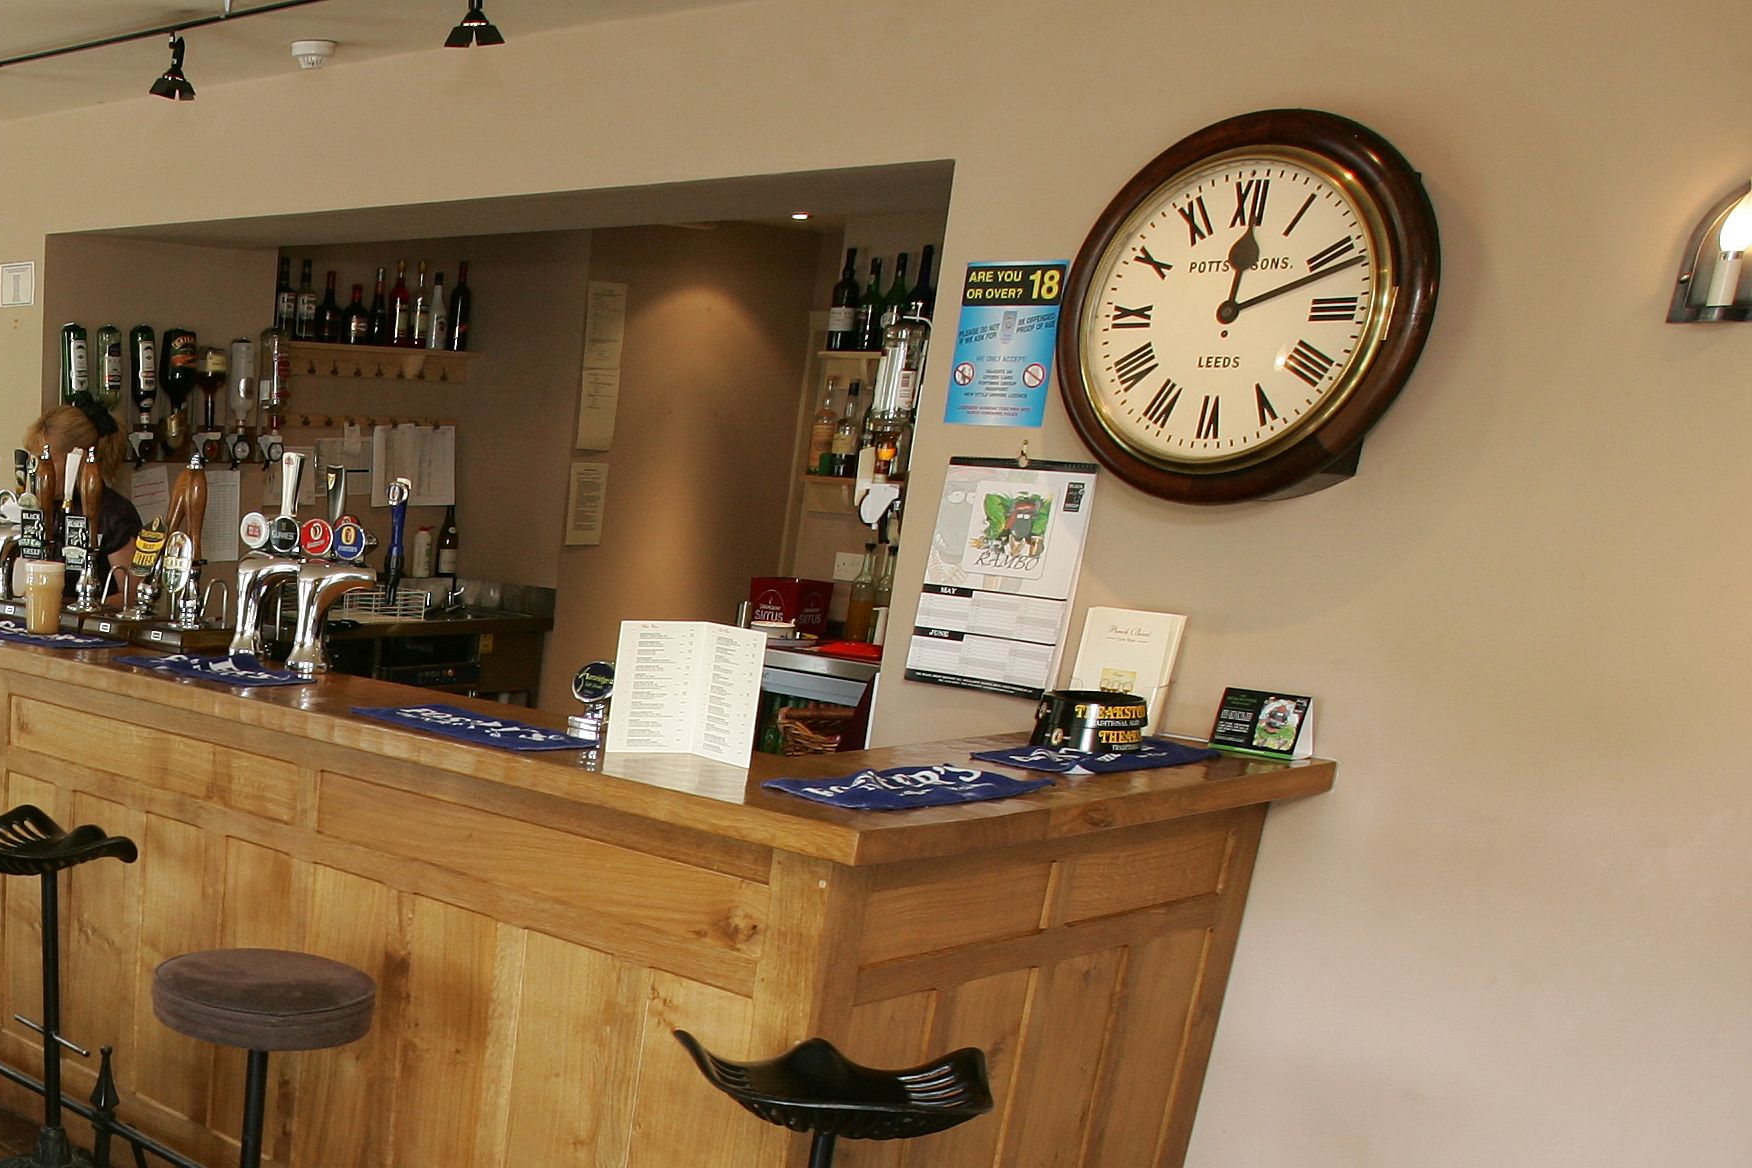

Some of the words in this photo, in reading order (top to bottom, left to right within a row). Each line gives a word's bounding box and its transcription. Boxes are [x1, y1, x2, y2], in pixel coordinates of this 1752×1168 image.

[1133, 245, 1173, 281] X
[1188, 260, 1230, 274] POTTS
[968, 271, 994, 283] ARE
[998, 270, 1023, 283] YOU
[1029, 269, 1060, 300] 18
[966, 288, 983, 300] OR
[985, 288, 1024, 299] OVER?
[1198, 356, 1240, 368] LEEDS
[973, 552, 1040, 571] RAMBO
